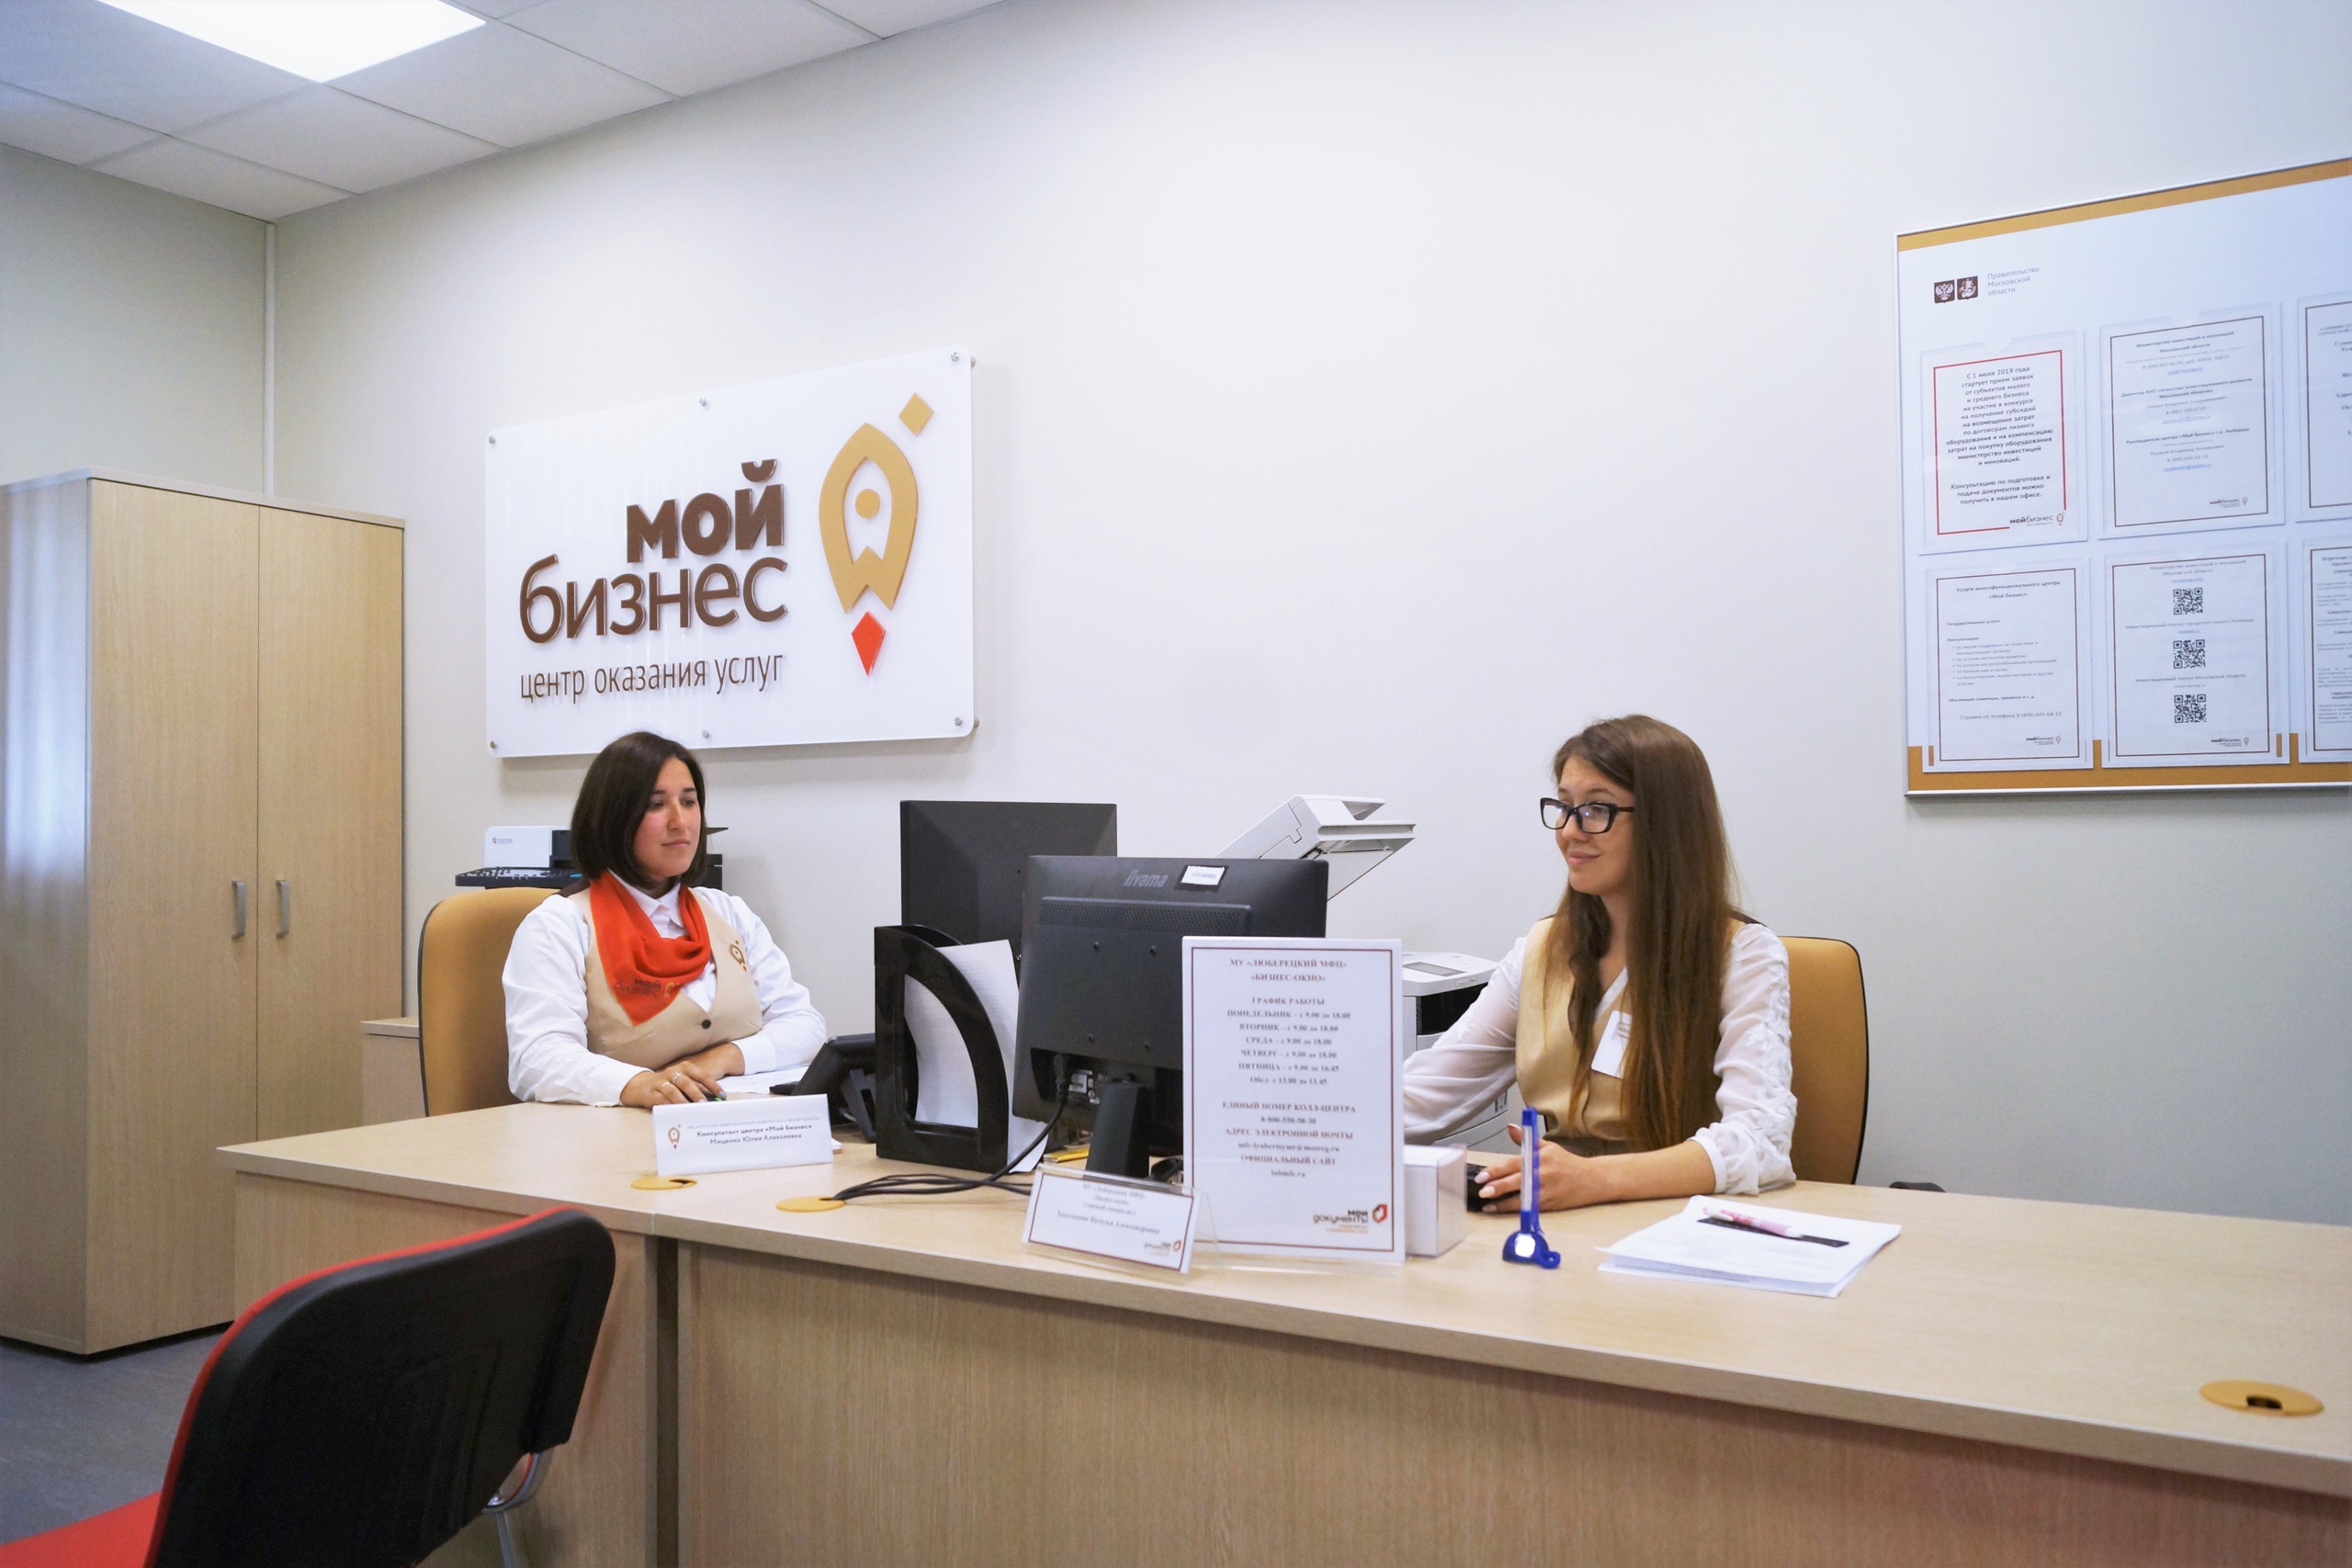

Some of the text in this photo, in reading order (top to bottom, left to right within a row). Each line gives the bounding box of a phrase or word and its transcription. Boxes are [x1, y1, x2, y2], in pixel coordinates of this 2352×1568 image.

[1987, 267, 2040, 279] Правительство
[1988, 276, 2030, 288] Московской
[1988, 287, 2016, 296] области
[1973, 386, 2006, 394] субъектов
[2004, 390, 2029, 399] бизнеса
[1973, 403, 1996, 412] участие
[2004, 399, 2033, 407] конкурсе
[1971, 411, 2004, 419] получение
[2006, 406, 2036, 415] субсидий
[1973, 418, 2012, 426] возмещение
[1973, 426, 2007, 434] договорам
[1946, 436, 1991, 446] оборудования
[2008, 429, 2052, 438] компенсацию
[1979, 442, 2004, 450] покупку
[2006, 437, 2052, 447] оборудования
[1958, 446, 2041, 460] министерство инвестиций
[1951, 480, 1996, 490] Консультацию
[1982, 487, 2019, 495] документов
[627, 458, 784, 563] мой
[520, 554, 787, 644] бизнес
[521, 655, 784, 704] центр оказания услуг
[1124, 869, 1169, 887] iiyama
